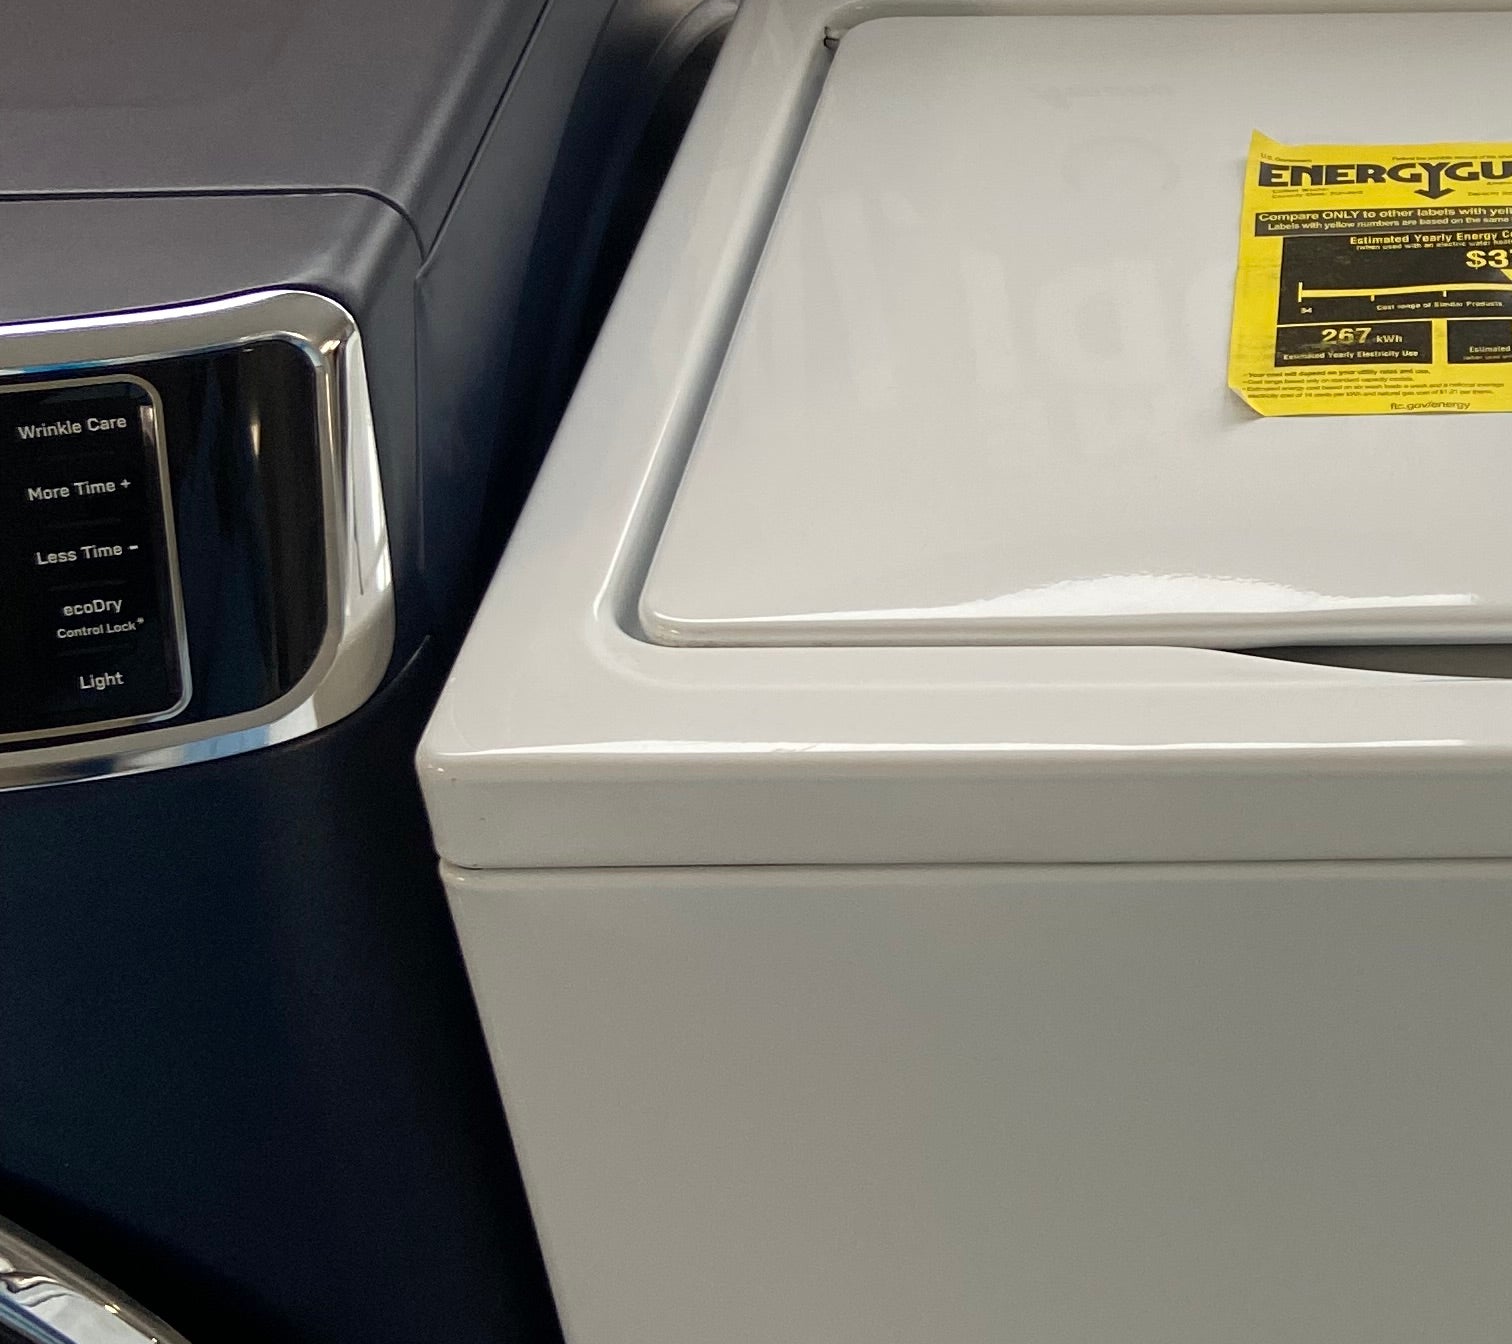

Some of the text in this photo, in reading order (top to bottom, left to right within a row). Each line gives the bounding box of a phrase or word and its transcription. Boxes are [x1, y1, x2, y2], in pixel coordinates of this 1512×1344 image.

[1259, 213, 1319, 223] Compare
[1322, 211, 1361, 221] ONLY
[1363, 210, 1376, 218] to
[1379, 209, 1413, 218] other
[1417, 208, 1456, 217] labels
[1459, 208, 1487, 216] with
[1350, 235, 1409, 245] Estimated
[1414, 233, 1452, 243] Yearly
[1456, 232, 1497, 242] Energy
[1321, 327, 1403, 345] 267 kWh
[17, 417, 127, 440] Wrinkle Care
[27, 481, 116, 501] More Time
[36, 545, 123, 565] Less Time
[63, 599, 122, 616] ecoDry
[57, 624, 104, 639] Control
[79, 672, 124, 690] Light
